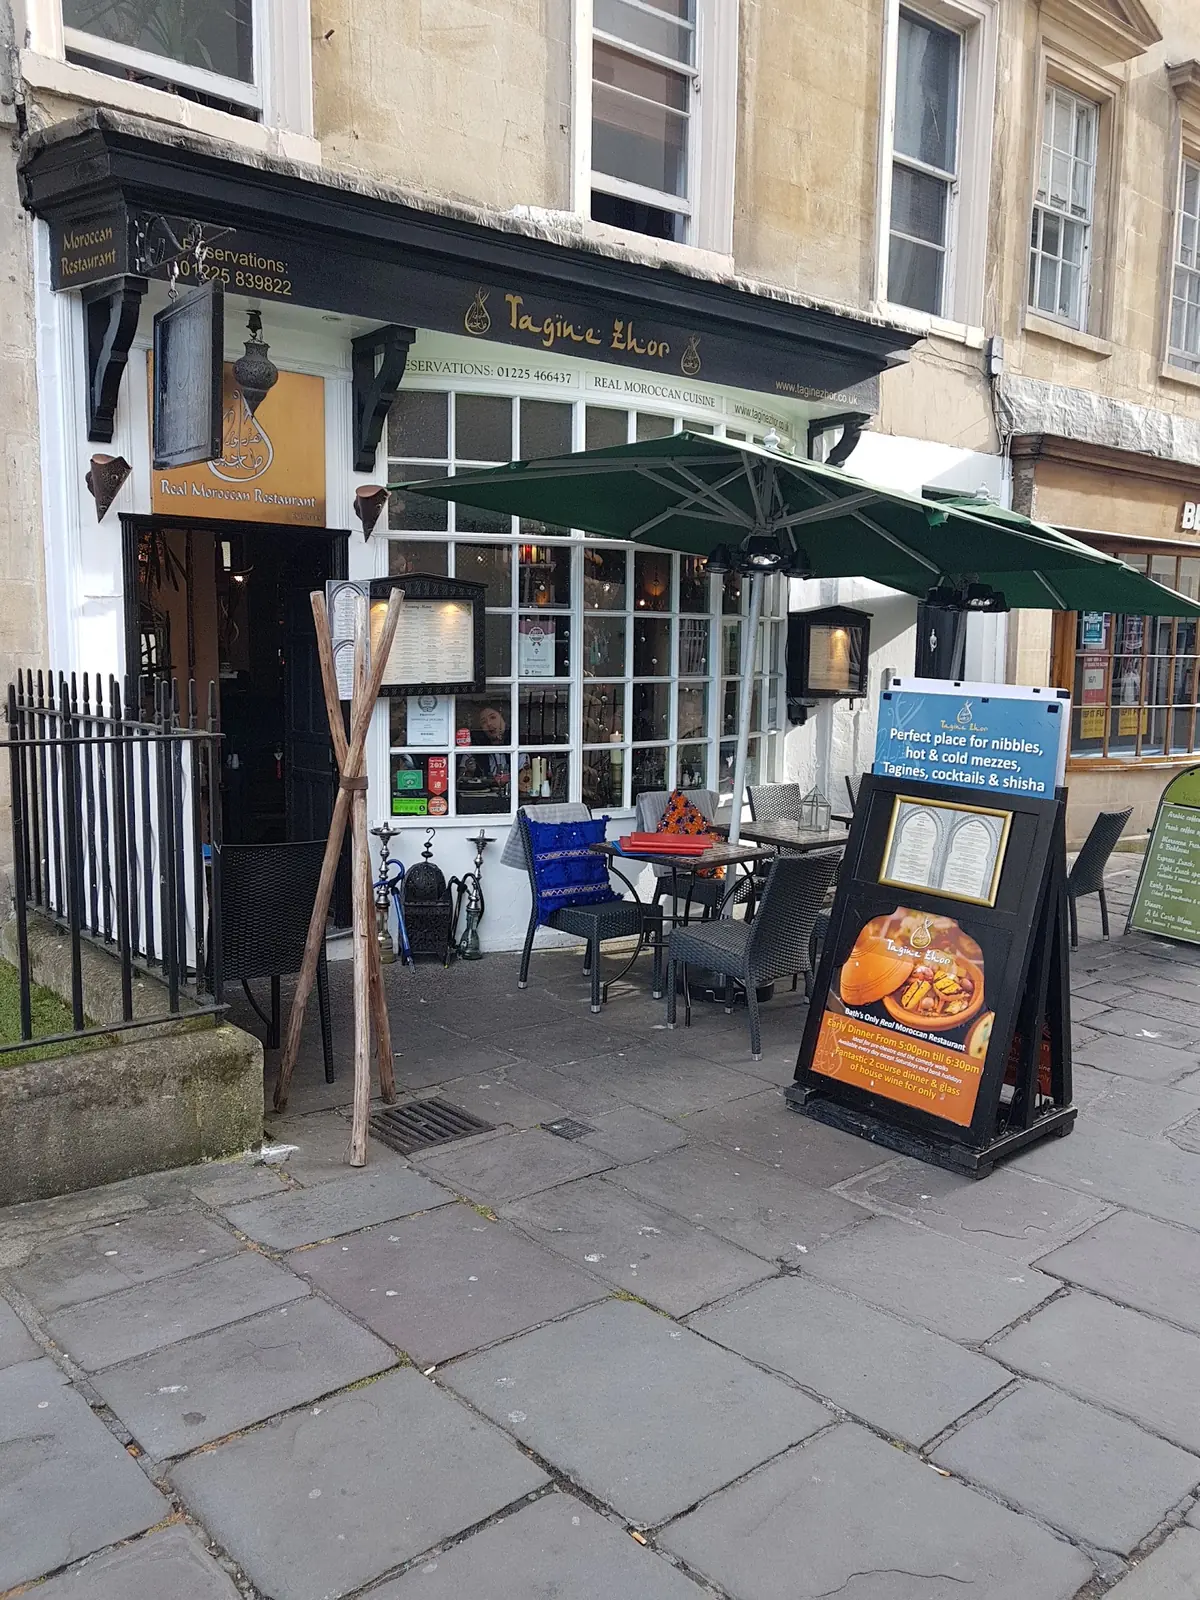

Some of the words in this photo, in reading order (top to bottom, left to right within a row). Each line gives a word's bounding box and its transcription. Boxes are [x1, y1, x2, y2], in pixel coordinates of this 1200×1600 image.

[63, 227, 113, 251] Moroccan
[61, 248, 116, 276] Restaurant
[181, 260, 231, 284] 01225
[235, 271, 292, 296] 839822
[404, 360, 494, 376] ESERVATIONS:
[497, 366, 530, 379] 01225
[533, 370, 572, 384] 466437
[594, 376, 622, 391] REAL
[624, 380, 682, 400] MOROCCAN
[683, 392, 716, 407] CUISINE
[775, 380, 859, 405] www.taginezhor.co.uk
[734, 403, 790, 432] www.taginezhor.co.uk
[160, 479, 187, 496] Real
[191, 483, 250, 501] Moroccan
[254, 488, 316, 507] Restaurant
[890, 728, 931, 743] Perfect
[933, 731, 966, 747] place
[969, 734, 988, 749] for
[991, 737, 1044, 756] nibbles,
[905, 746, 926, 760] hot
[928, 749, 939, 761] &
[941, 751, 967, 765] cold
[971, 756, 1022, 772] mezzes,
[882, 761, 929, 780] Tagines,
[932, 768, 985, 785] cocktails
[988, 773, 1000, 786] &
[1002, 775, 1045, 792] shisha
[845, 1008, 864, 1019] Bath's
[864, 1014, 880, 1025] Only
[880, 1018, 895, 1028] Real
[895, 1022, 928, 1039] Moroccan
[928, 1033, 966, 1051] Restaurant
[827, 1018, 847, 1032] Early
[848, 1025, 875, 1039] Dinner
[875, 1033, 897, 1047] From
[898, 1041, 931, 1058] 5:00pm
[932, 1051, 945, 1062] till
[945, 1056, 980, 1074] 6:30pm
[835, 1046, 868, 1064] Fantastic
[869, 1058, 875, 1067] 2
[875, 1062, 902, 1076] course
[902, 1070, 929, 1085] dinner
[930, 1079, 938, 1089] &
[939, 1082, 961, 1096] glass
[850, 1063, 859, 1071] of
[859, 1065, 883, 1080] house
[884, 1075, 904, 1087] wine
[904, 1080, 917, 1092] for
[918, 1087, 937, 1100] only
